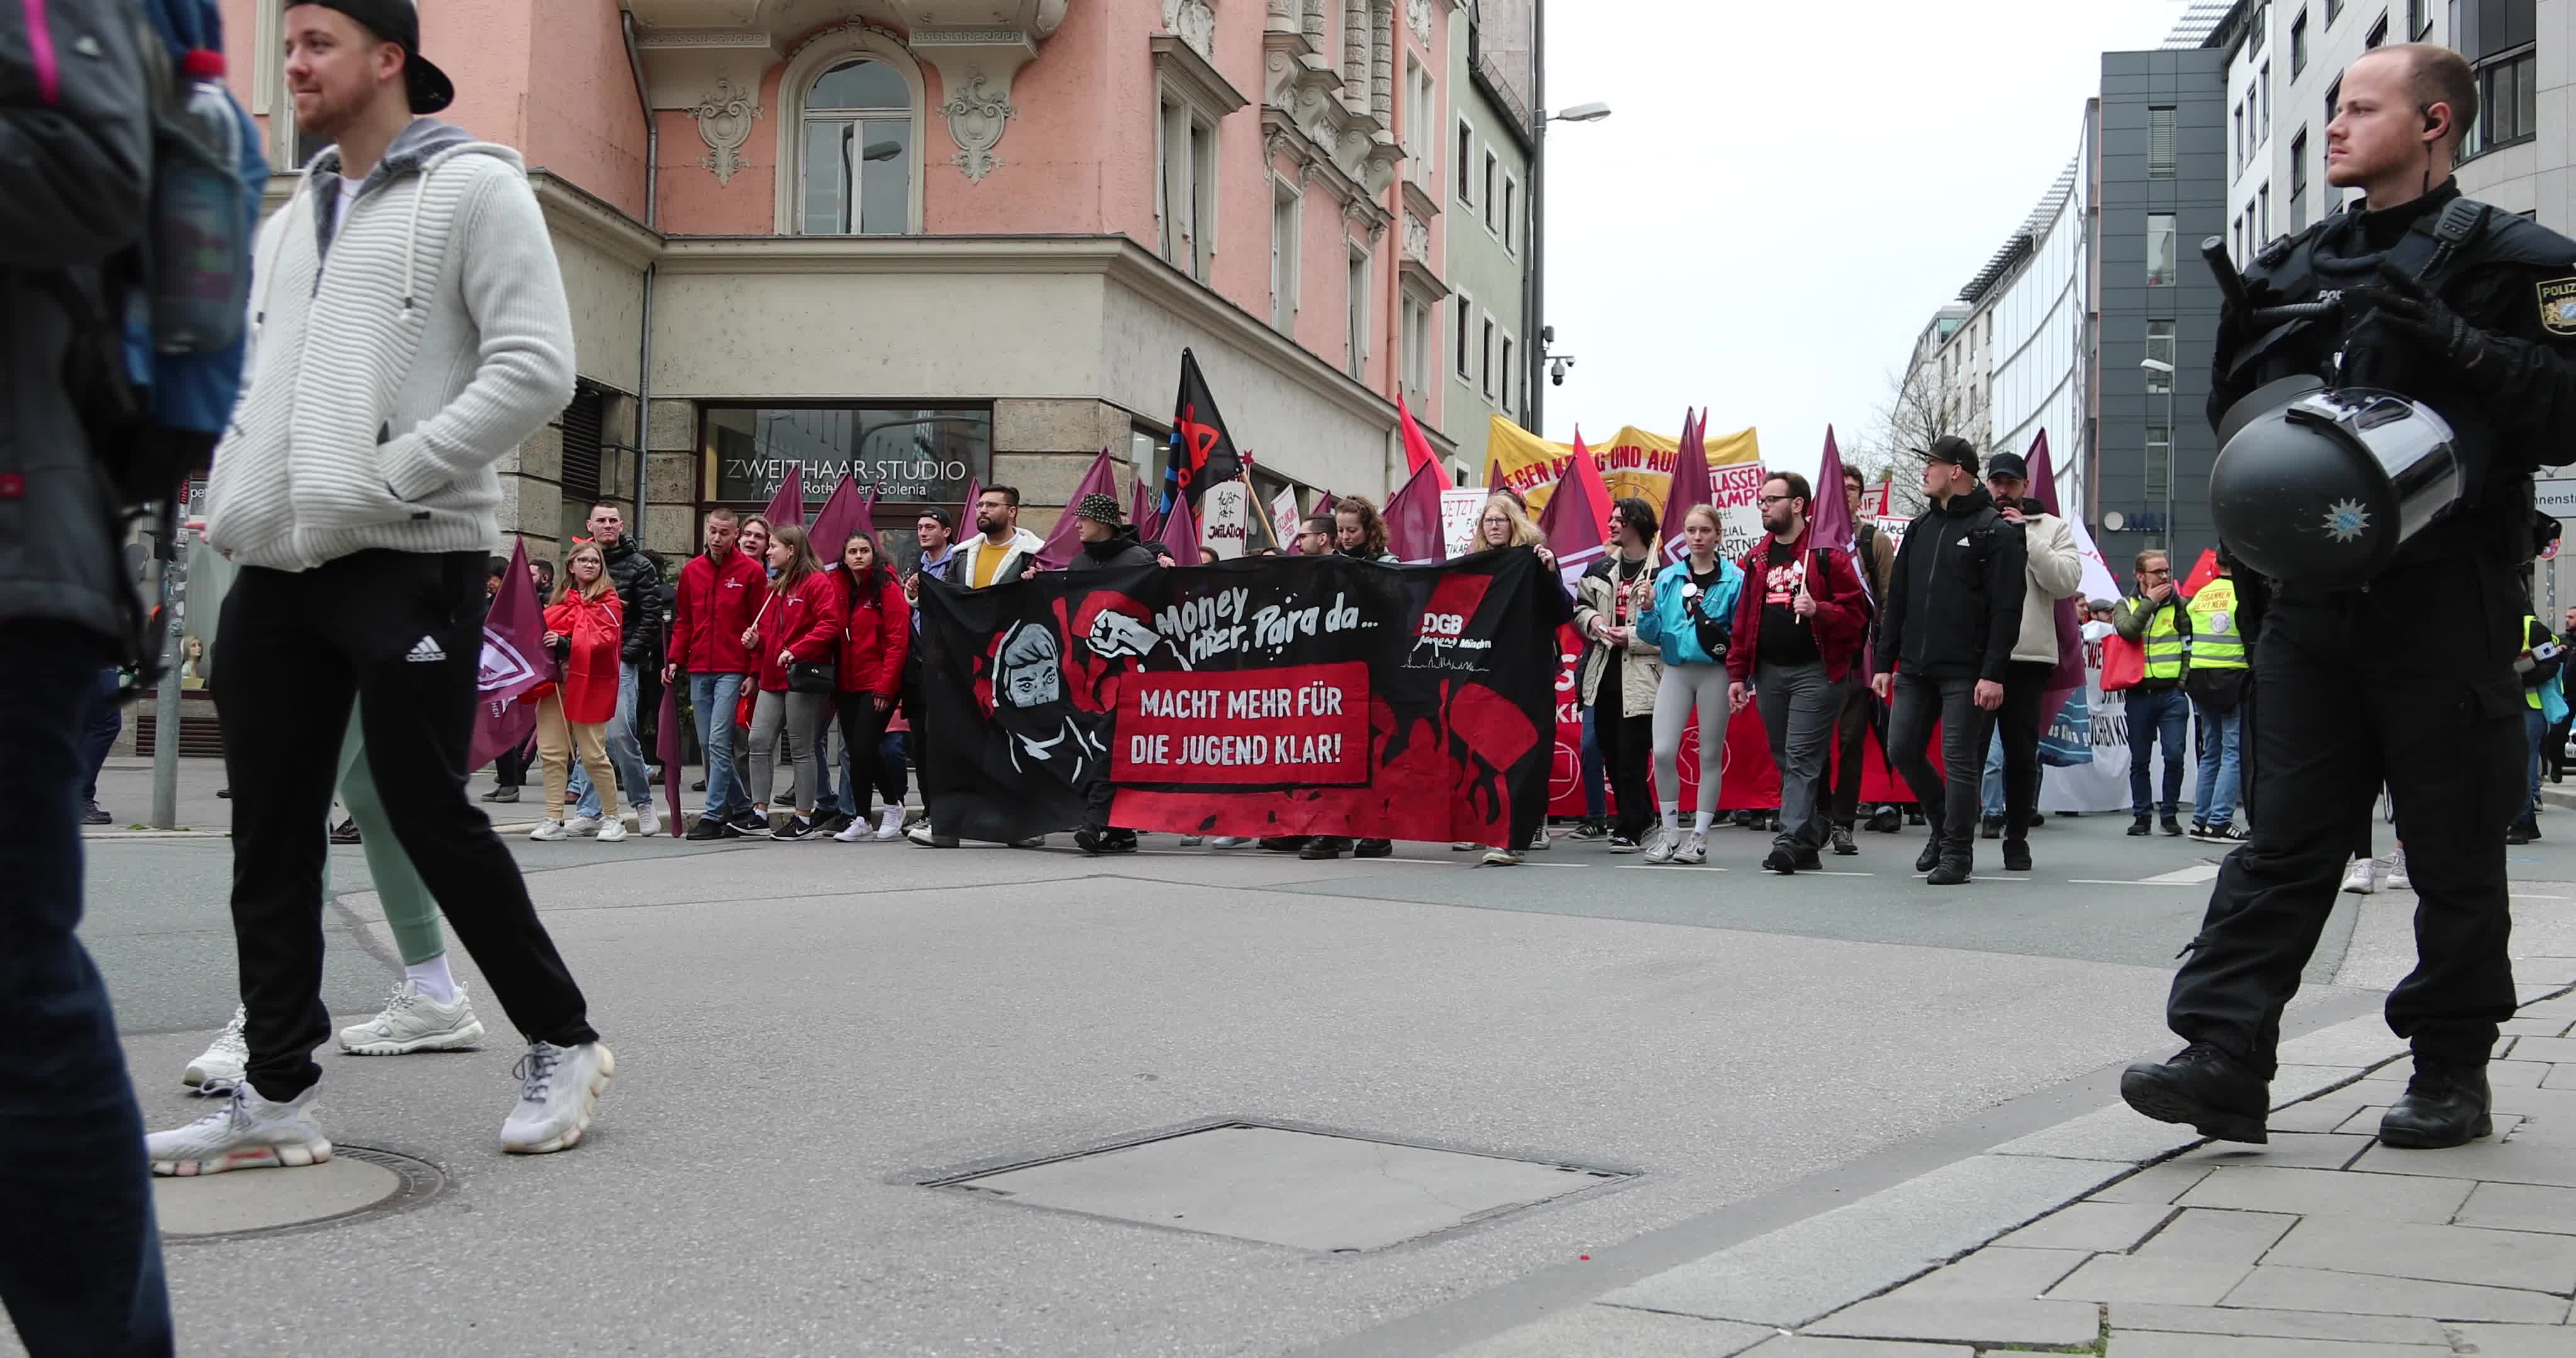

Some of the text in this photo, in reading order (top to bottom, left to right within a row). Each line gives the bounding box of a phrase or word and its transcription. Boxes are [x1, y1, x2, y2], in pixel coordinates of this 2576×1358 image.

[724, 460, 966, 481] ZWEITHAAR-STUDIO
[1504, 461, 1550, 490] EGEN
[1610, 444, 1641, 470] UND
[1709, 466, 1767, 494] LASSEN
[1441, 499, 1477, 517] JETZT
[2535, 493, 2576, 505] nenst
[1722, 525, 1746, 537] ZIAL
[1717, 536, 1765, 553] ARTNE
[1155, 587, 1248, 641] Money
[1251, 605, 1320, 648] Para
[1421, 613, 1463, 635] DGB
[1140, 680, 1343, 719] MACHT MEHR FÜR
[1131, 733, 1342, 765] DIE JUGEND KLAR!
